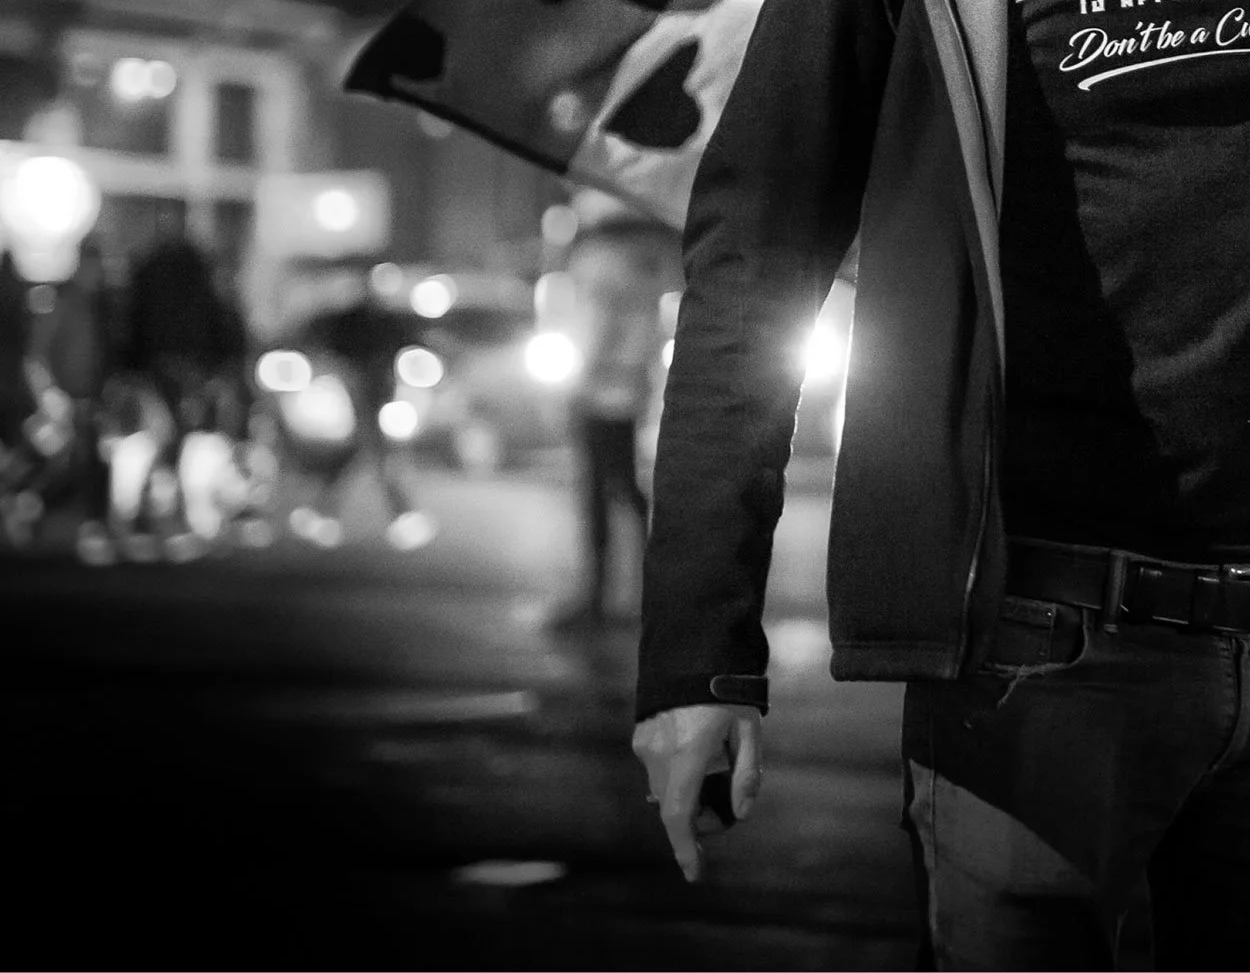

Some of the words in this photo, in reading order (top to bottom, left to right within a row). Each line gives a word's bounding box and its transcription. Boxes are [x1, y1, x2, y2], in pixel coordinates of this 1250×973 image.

[1059, 21, 1157, 71] Don't
[1156, 21, 1185, 50] be
[1190, 27, 1209, 45] a
